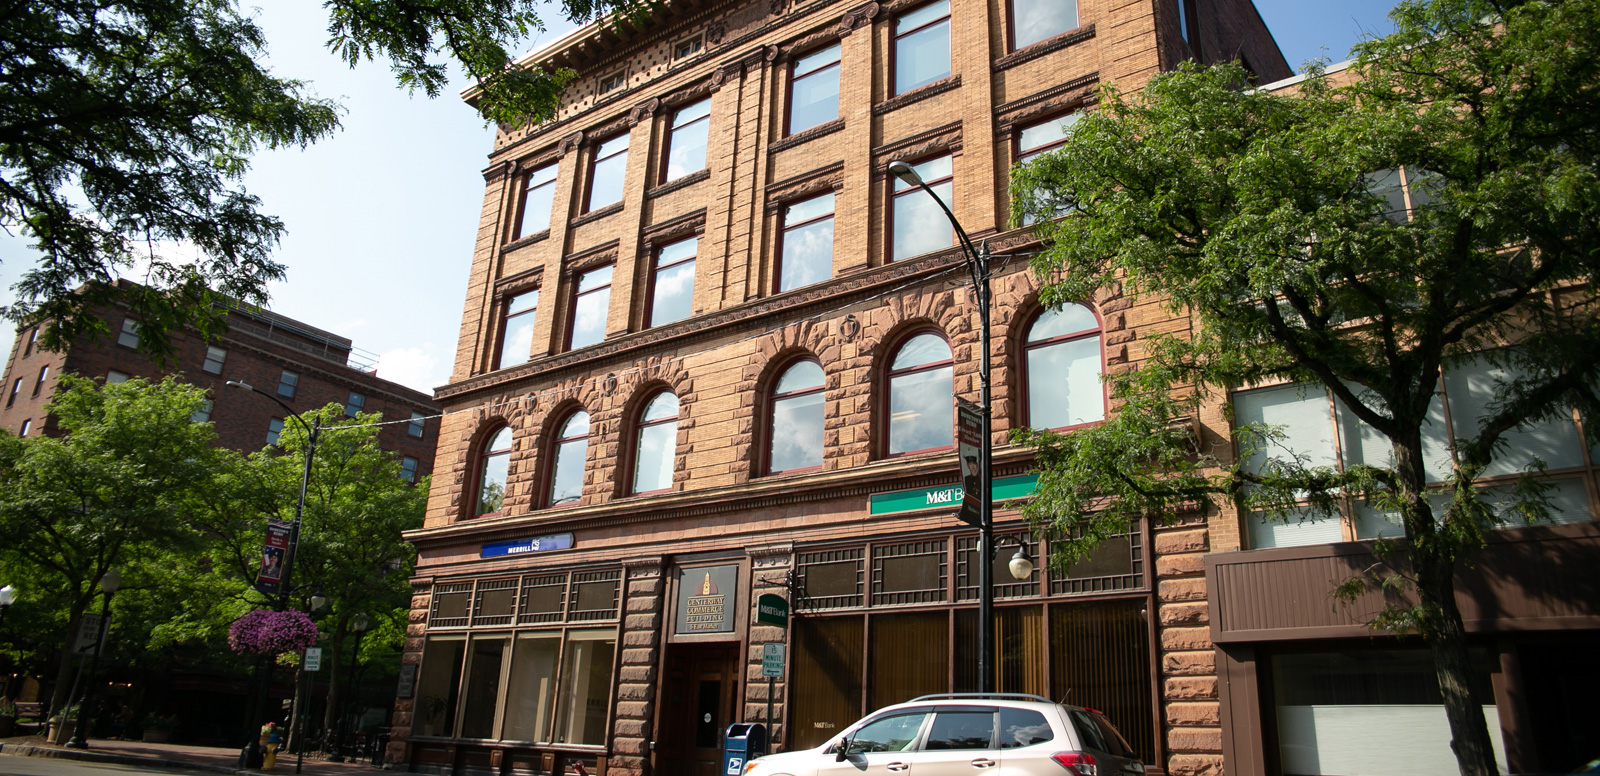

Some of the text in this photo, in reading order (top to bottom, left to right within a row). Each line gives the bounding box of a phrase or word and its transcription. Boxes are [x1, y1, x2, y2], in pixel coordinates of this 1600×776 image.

[926, 489, 954, 505] M&T
[508, 545, 531, 554] MERRILL
[687, 598, 725, 606] CENTERWAY
[687, 606, 724, 614] COMMERCE
[85, 617, 102, 626] STO
